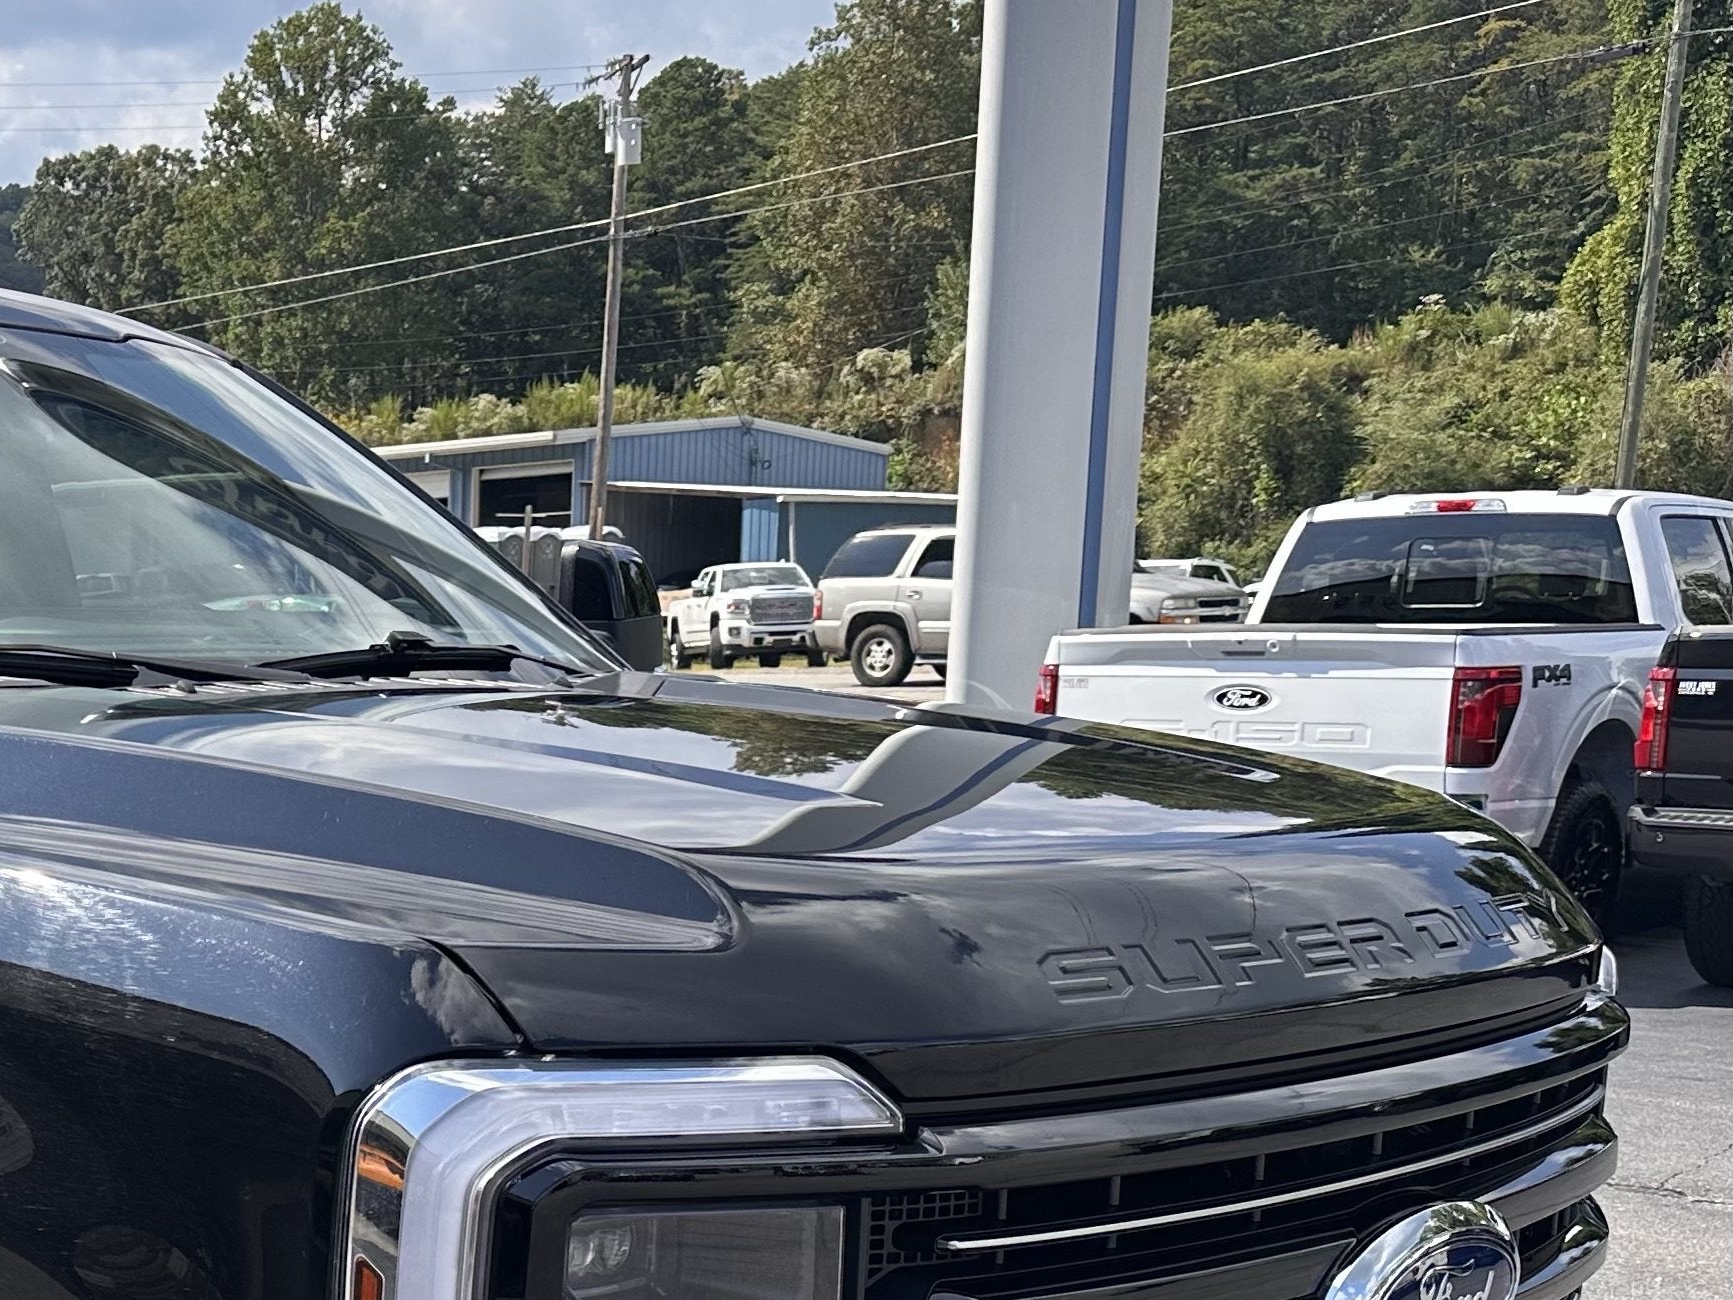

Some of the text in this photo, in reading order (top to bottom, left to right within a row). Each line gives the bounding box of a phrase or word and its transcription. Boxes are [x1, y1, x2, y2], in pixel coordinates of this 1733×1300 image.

[1532, 664, 1571, 688] FX4
[1035, 888, 1569, 1003] SUPER DUTY
